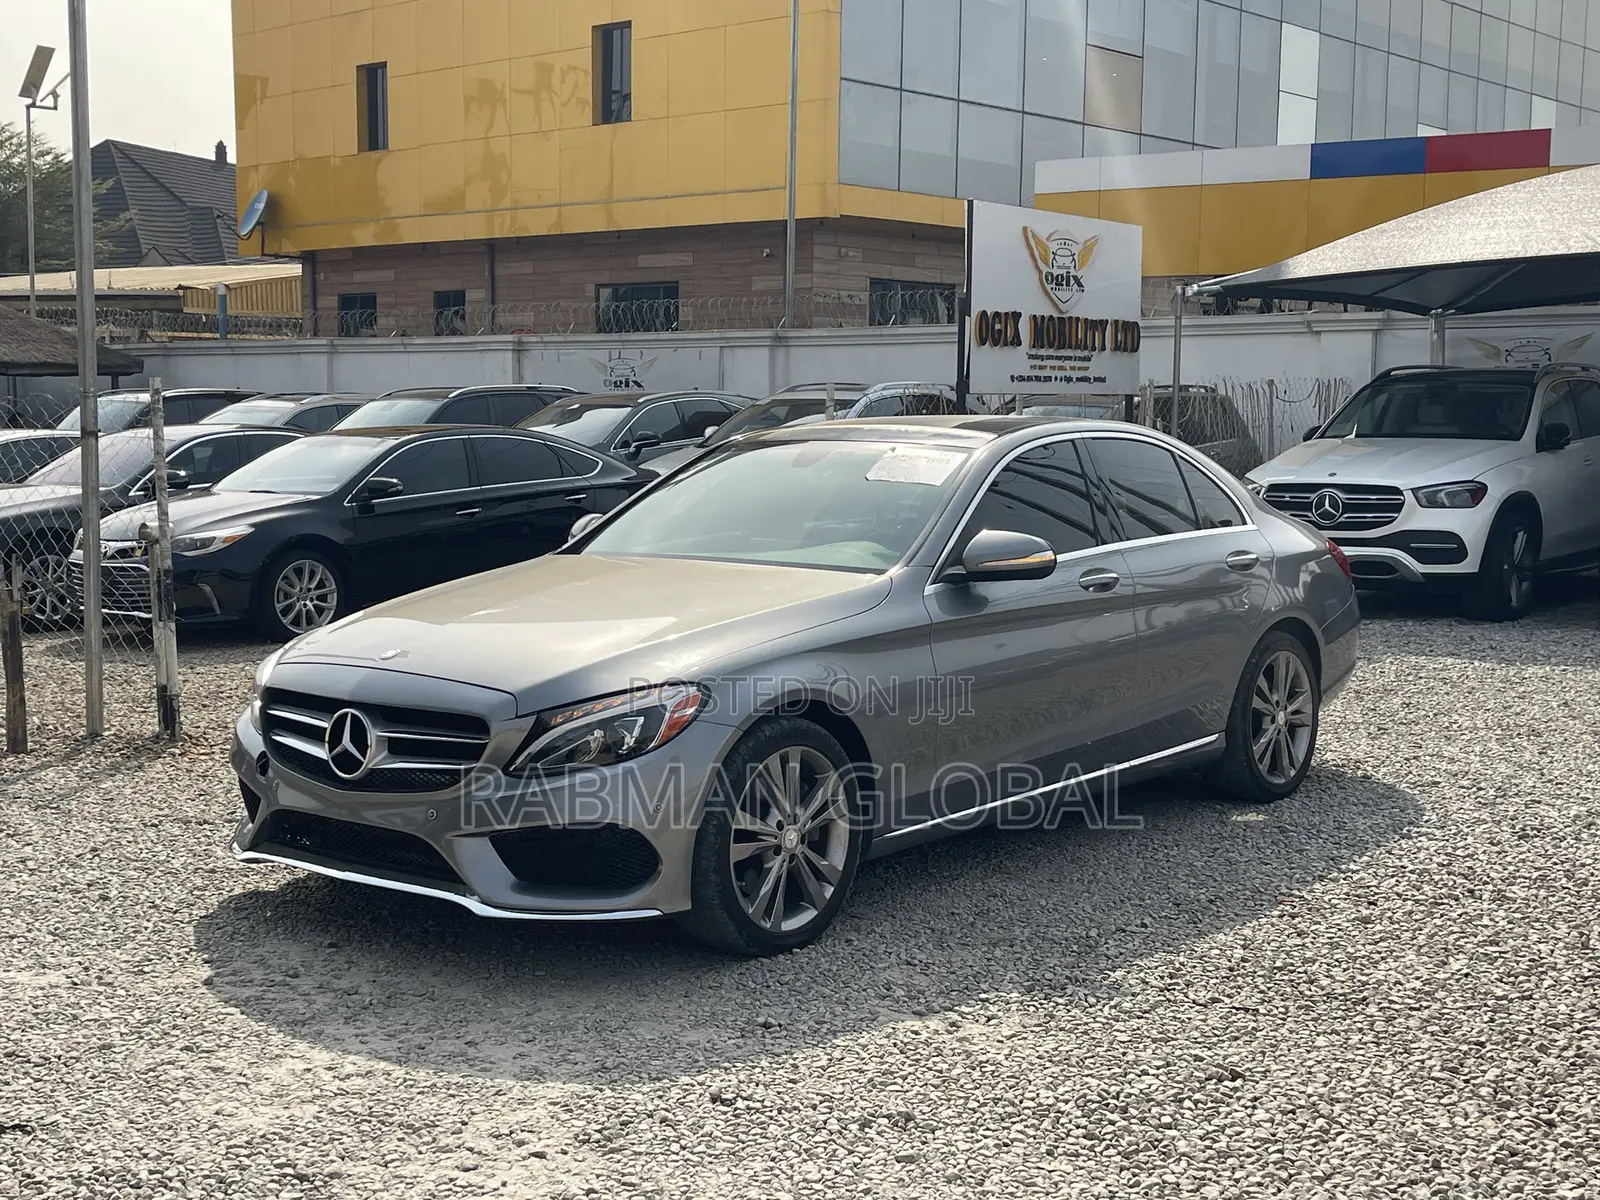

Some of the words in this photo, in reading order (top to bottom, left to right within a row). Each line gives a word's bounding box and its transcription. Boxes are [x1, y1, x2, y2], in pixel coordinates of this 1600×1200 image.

[1044, 270, 1085, 288] Ogix
[975, 309, 1022, 347] OGIX
[1029, 314, 1109, 352] MOBILITY
[1110, 319, 1141, 353] LTD
